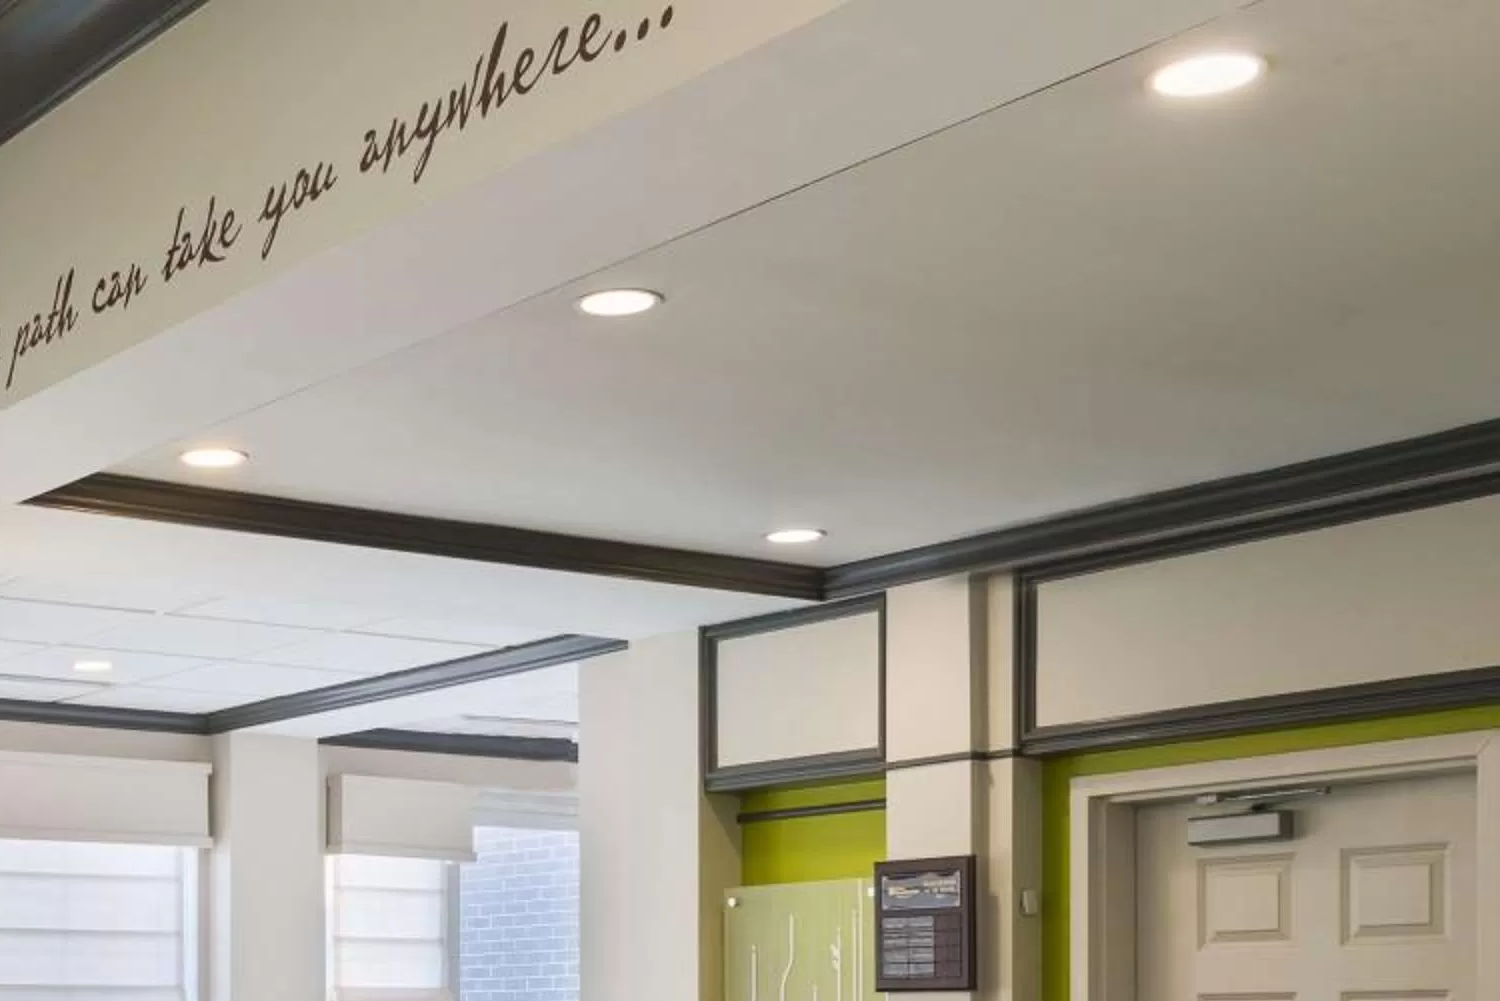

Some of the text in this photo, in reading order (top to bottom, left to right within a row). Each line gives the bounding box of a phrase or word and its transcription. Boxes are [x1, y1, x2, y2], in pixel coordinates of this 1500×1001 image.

[5, 267, 80, 390] path
[91, 263, 149, 314] can
[161, 196, 244, 283] take
[257, 160, 339, 261] you
